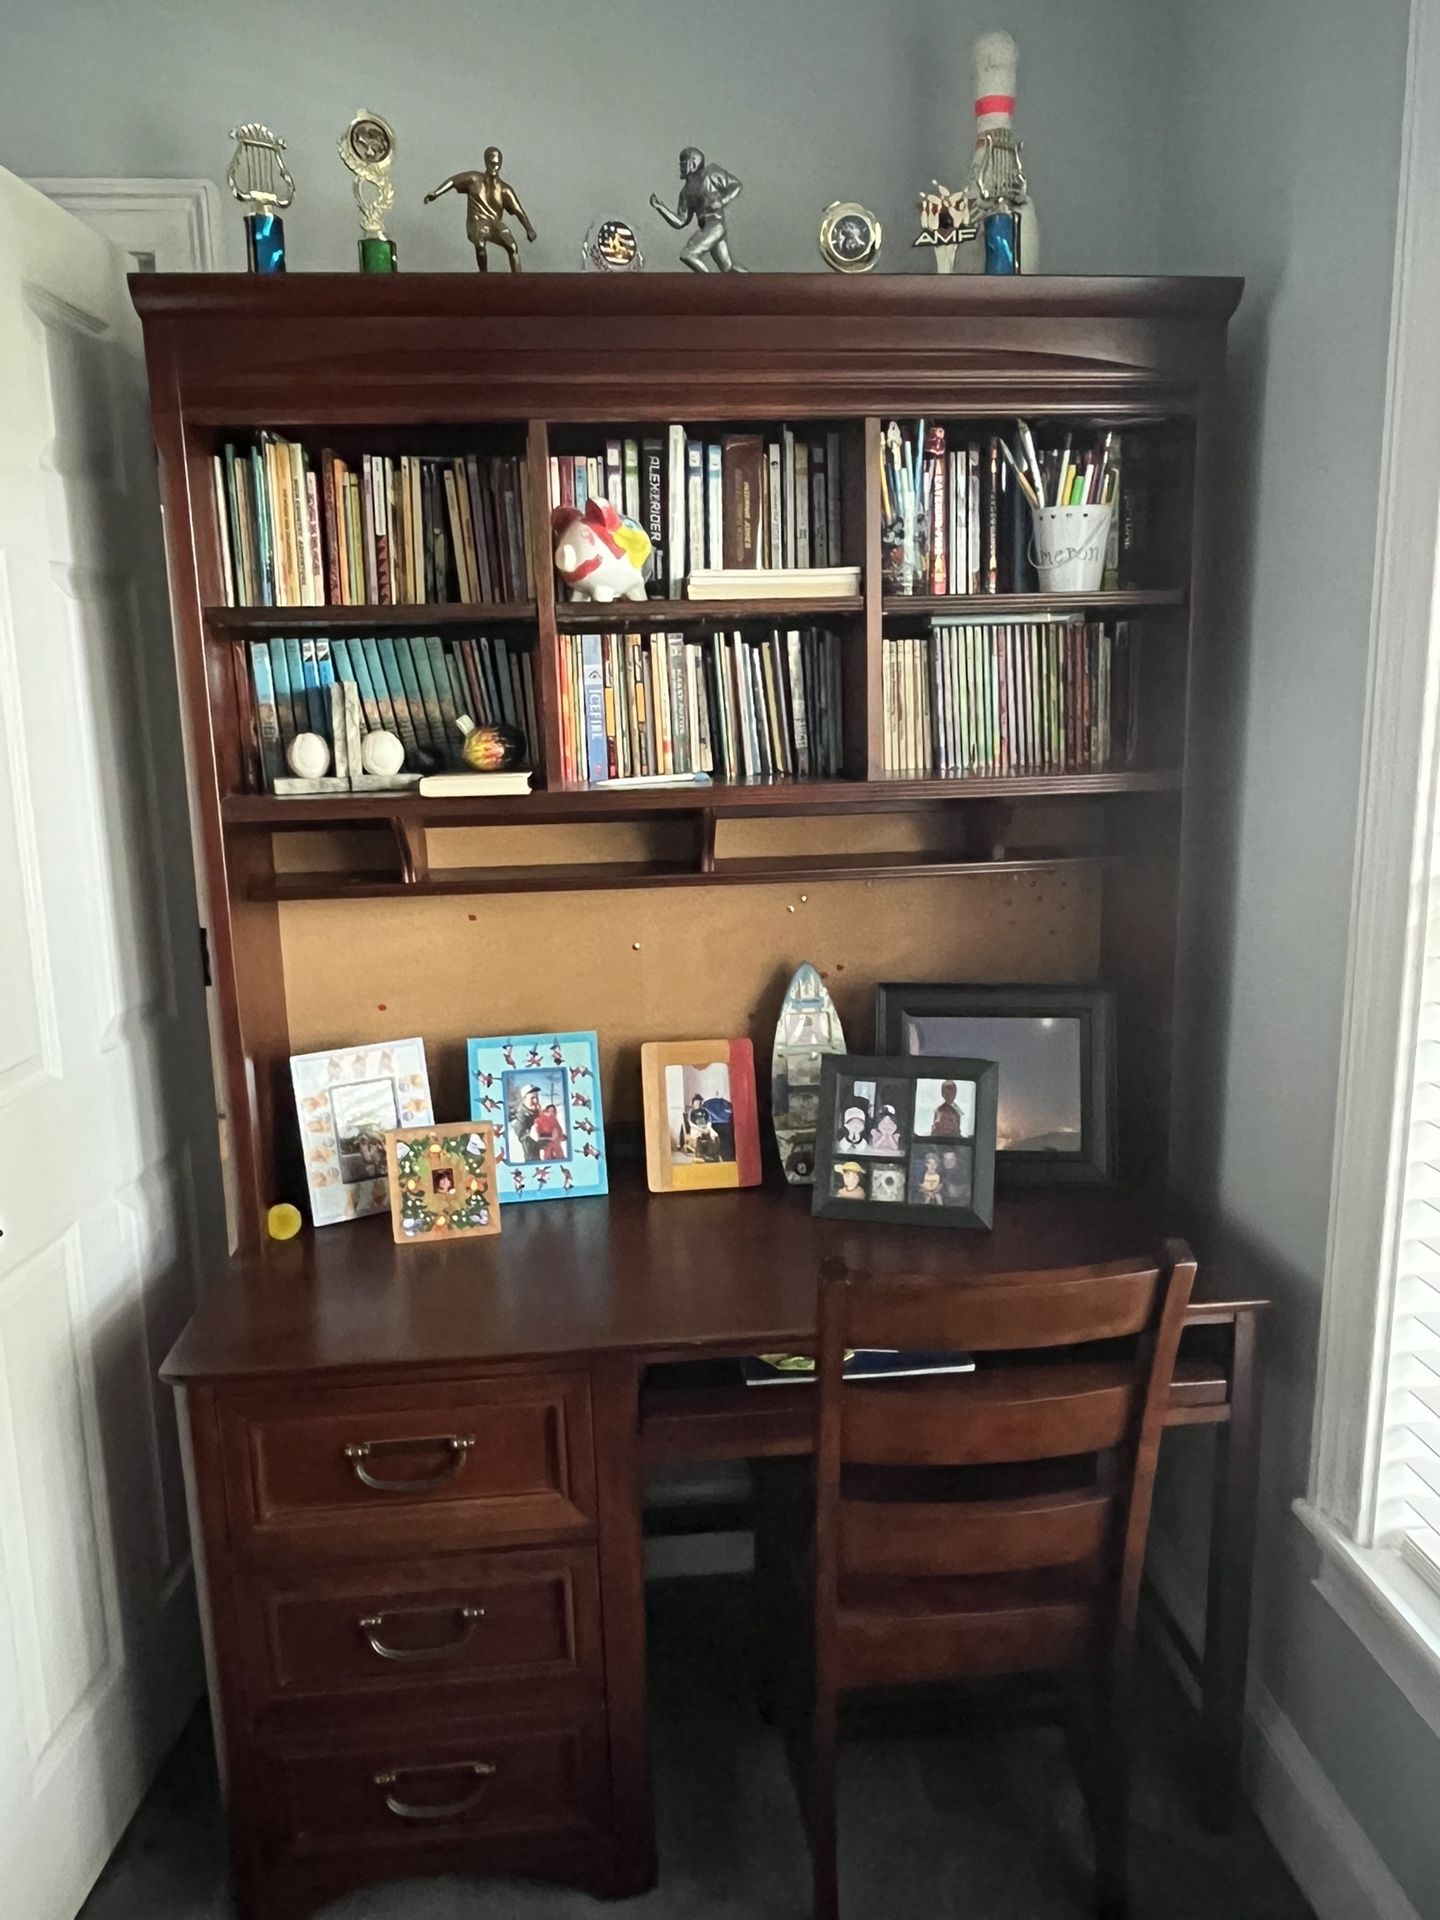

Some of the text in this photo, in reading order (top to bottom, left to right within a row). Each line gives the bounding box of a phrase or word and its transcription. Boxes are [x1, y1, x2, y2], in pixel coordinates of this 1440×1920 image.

[914, 229, 977, 246] AMF
[648, 456, 662, 490] ALEX
[649, 500, 662, 541] RIDER
